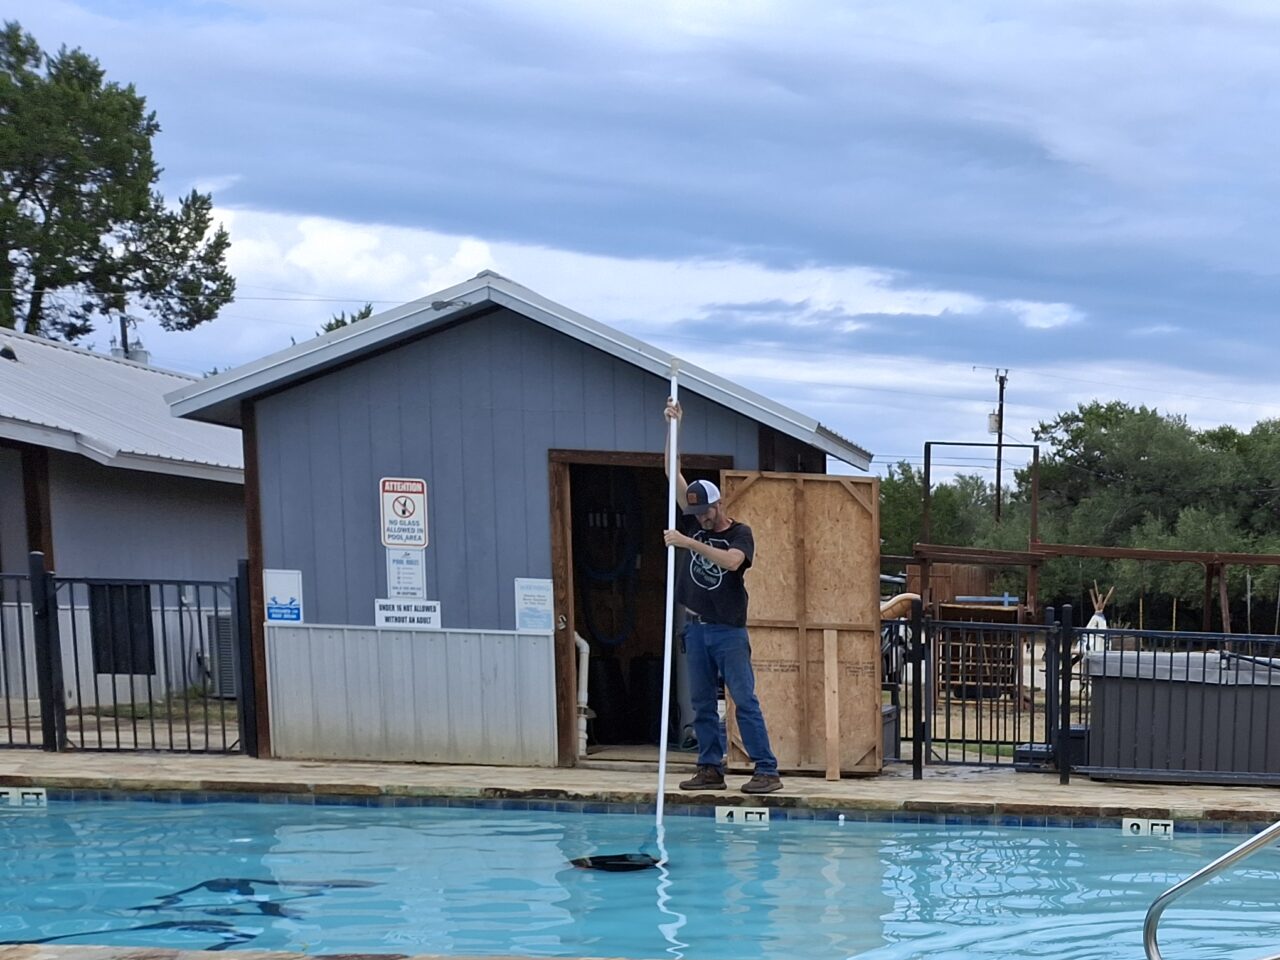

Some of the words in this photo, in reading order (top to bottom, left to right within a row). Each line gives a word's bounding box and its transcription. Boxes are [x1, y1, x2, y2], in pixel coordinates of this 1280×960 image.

[384, 481, 423, 492] ATTENTION
[386, 526, 415, 534] ALLOWED
[379, 604, 395, 612] UNDER
[414, 605, 437, 613] ALLOWED
[384, 615, 408, 623] WITHOUT
[745, 811, 766, 822] FT
[1150, 823, 1171, 835] FT
